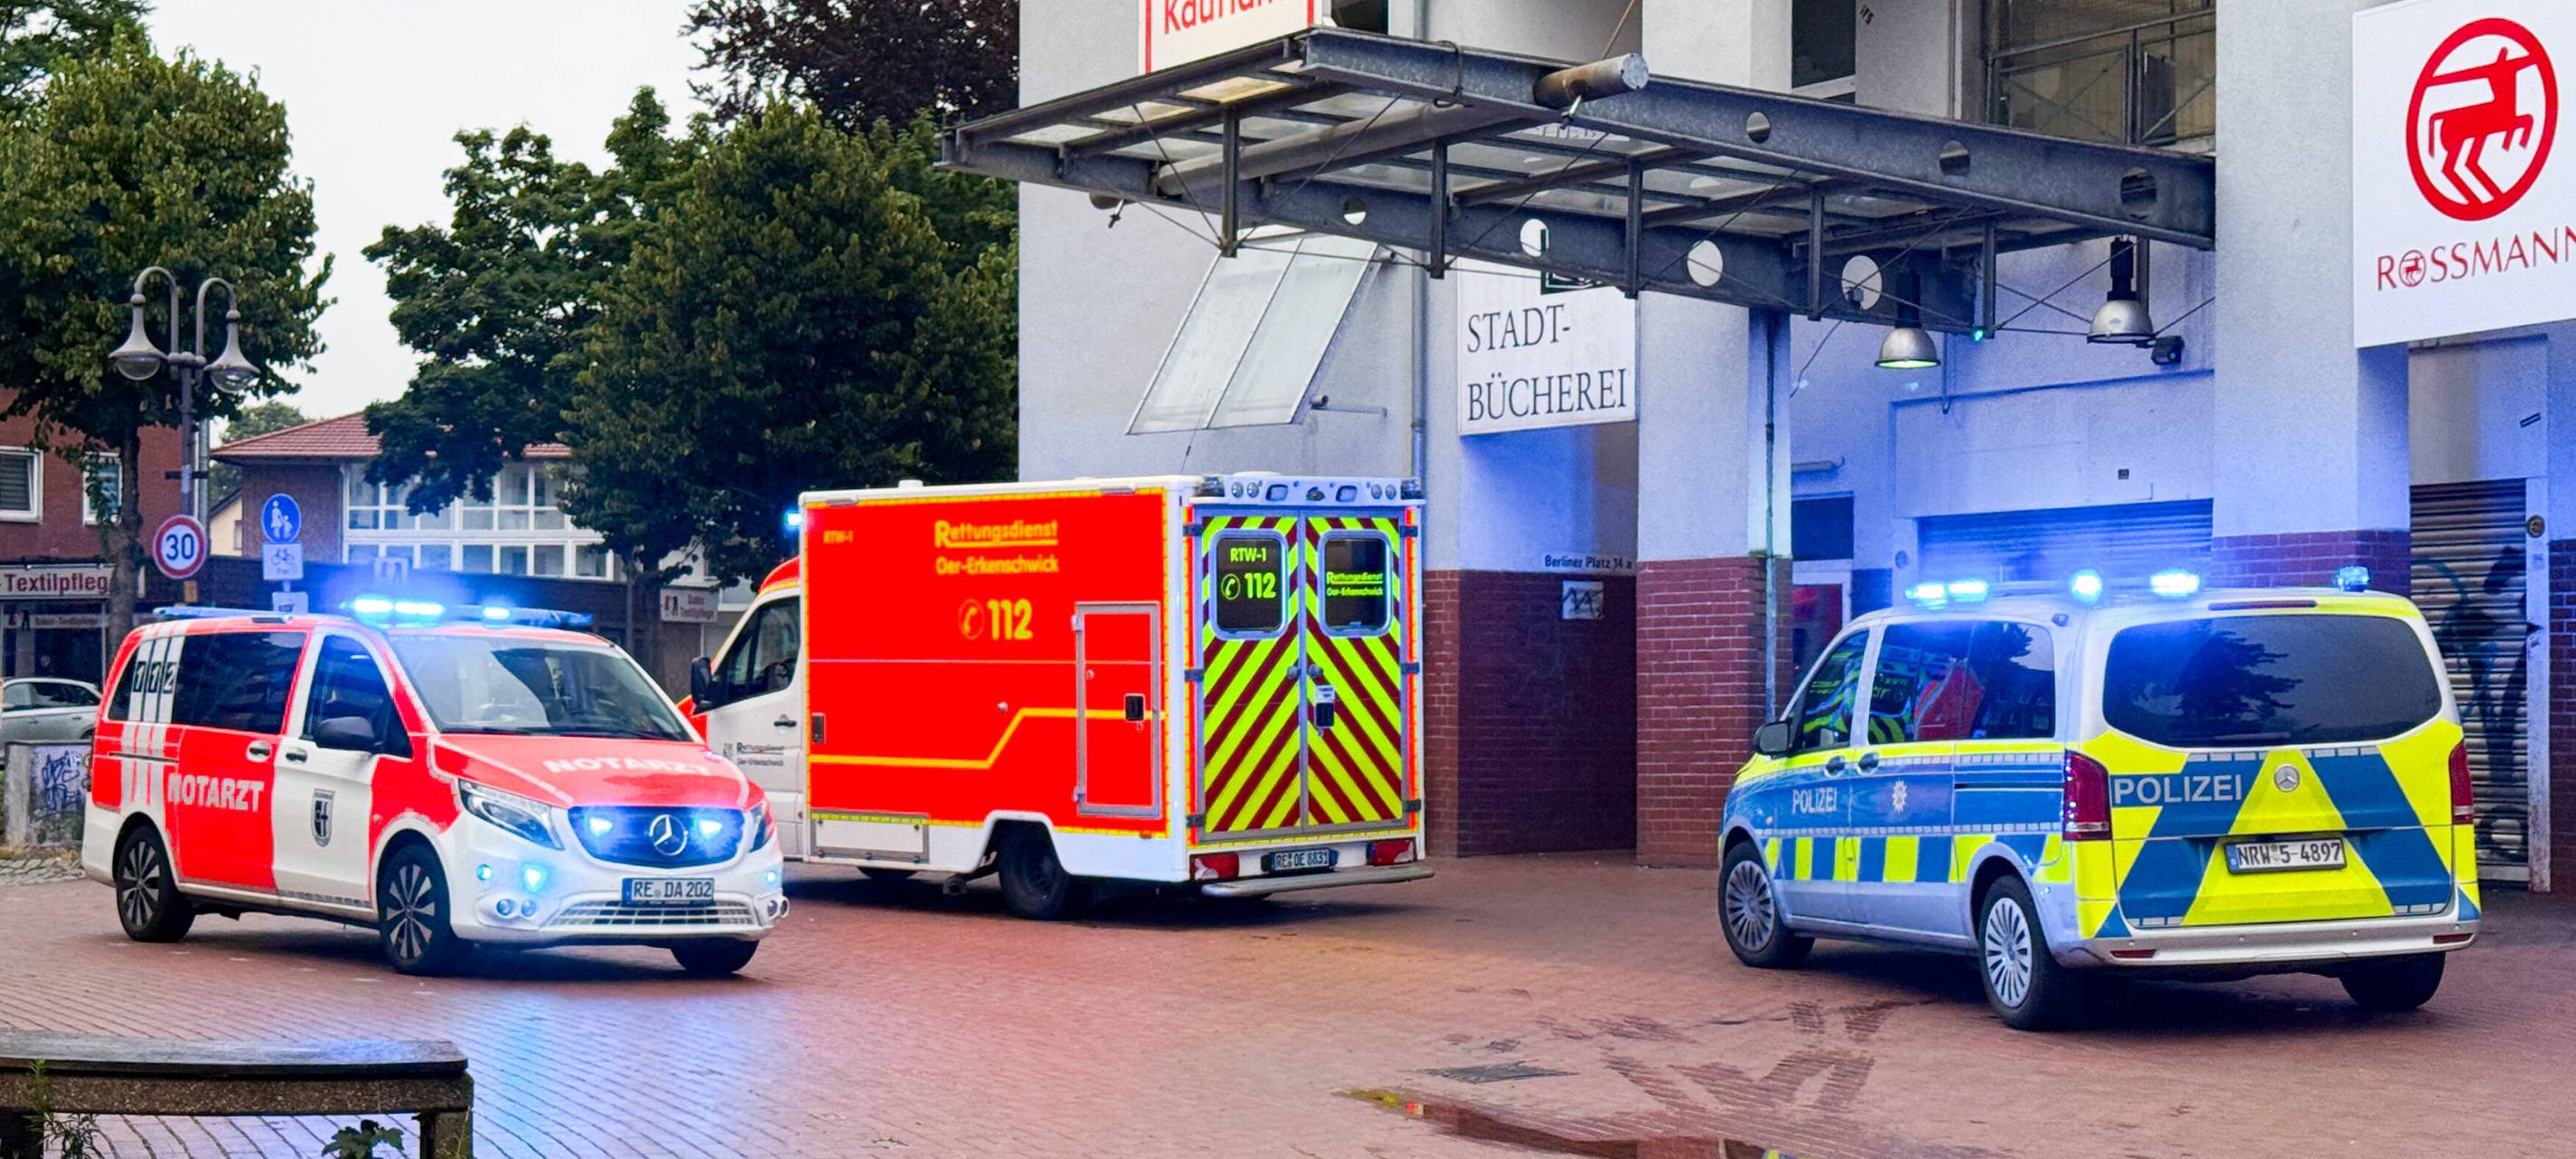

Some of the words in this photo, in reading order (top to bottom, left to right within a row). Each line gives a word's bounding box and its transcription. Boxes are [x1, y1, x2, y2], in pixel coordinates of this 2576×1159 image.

[1466, 303, 1571, 353] STADT-
[1467, 369, 1628, 422] BÜCHEREI
[165, 532, 195, 560] 30
[935, 520, 1059, 548] Rettungsdienst
[935, 554, 1060, 575] Oer-Erkenschwick
[1229, 547, 1267, 563] RTW-1
[1544, 554, 1583, 569] Berliner
[1585, 556, 1611, 570] Platz
[4, 572, 109, 596] Textilpfleg
[1244, 571, 1277, 599] 112
[1326, 571, 1384, 585] Rettungsdienst
[986, 599, 1033, 640] 112
[132, 661, 178, 694] 112
[543, 757, 711, 776] NOTARZT
[167, 771, 265, 812] NOTARZT
[1792, 787, 1839, 814] POLIZEI
[2113, 774, 2243, 804] POLIZEI
[1276, 854, 1289, 867] RE
[2237, 846, 2271, 869] NRW
[2279, 842, 2342, 865] 5-4897
[634, 881, 654, 898] RE
[663, 881, 683, 898] DA
[685, 881, 712, 898] 202
